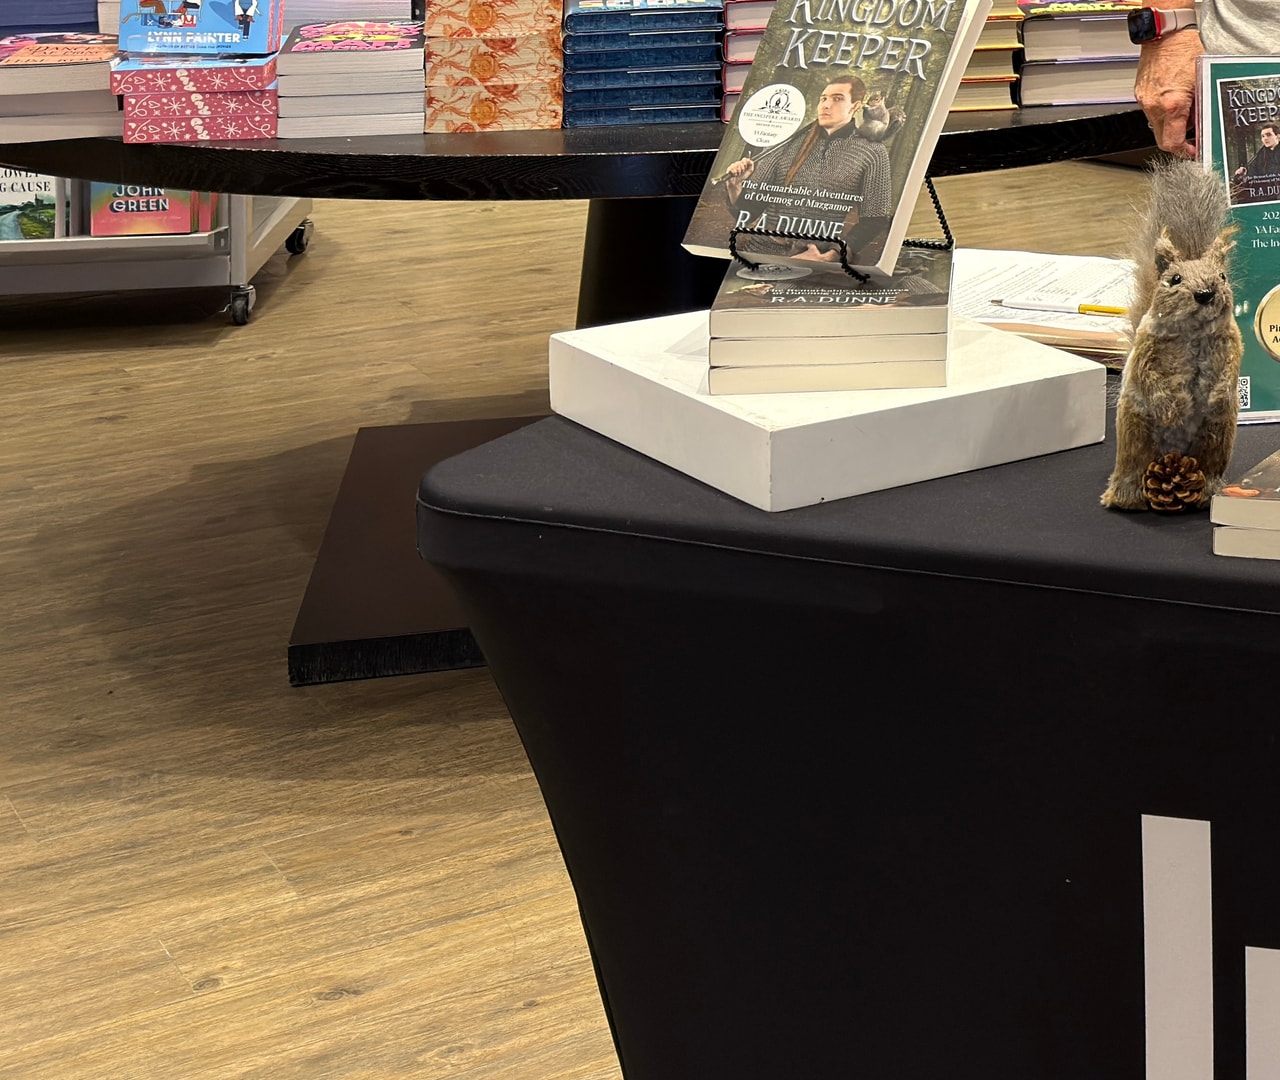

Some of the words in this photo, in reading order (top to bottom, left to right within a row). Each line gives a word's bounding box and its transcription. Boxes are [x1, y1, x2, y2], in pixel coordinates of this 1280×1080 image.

[776, 26, 932, 81] KEEPER
[741, 180, 758, 190] The
[759, 181, 812, 197] Remarkable
[814, 189, 864, 202] Adventures
[744, 192, 754, 201] of
[755, 194, 793, 206] Odemog
[794, 198, 804, 207] of
[806, 198, 853, 212] Mazgamor
[1251, 240, 1269, 248] The
